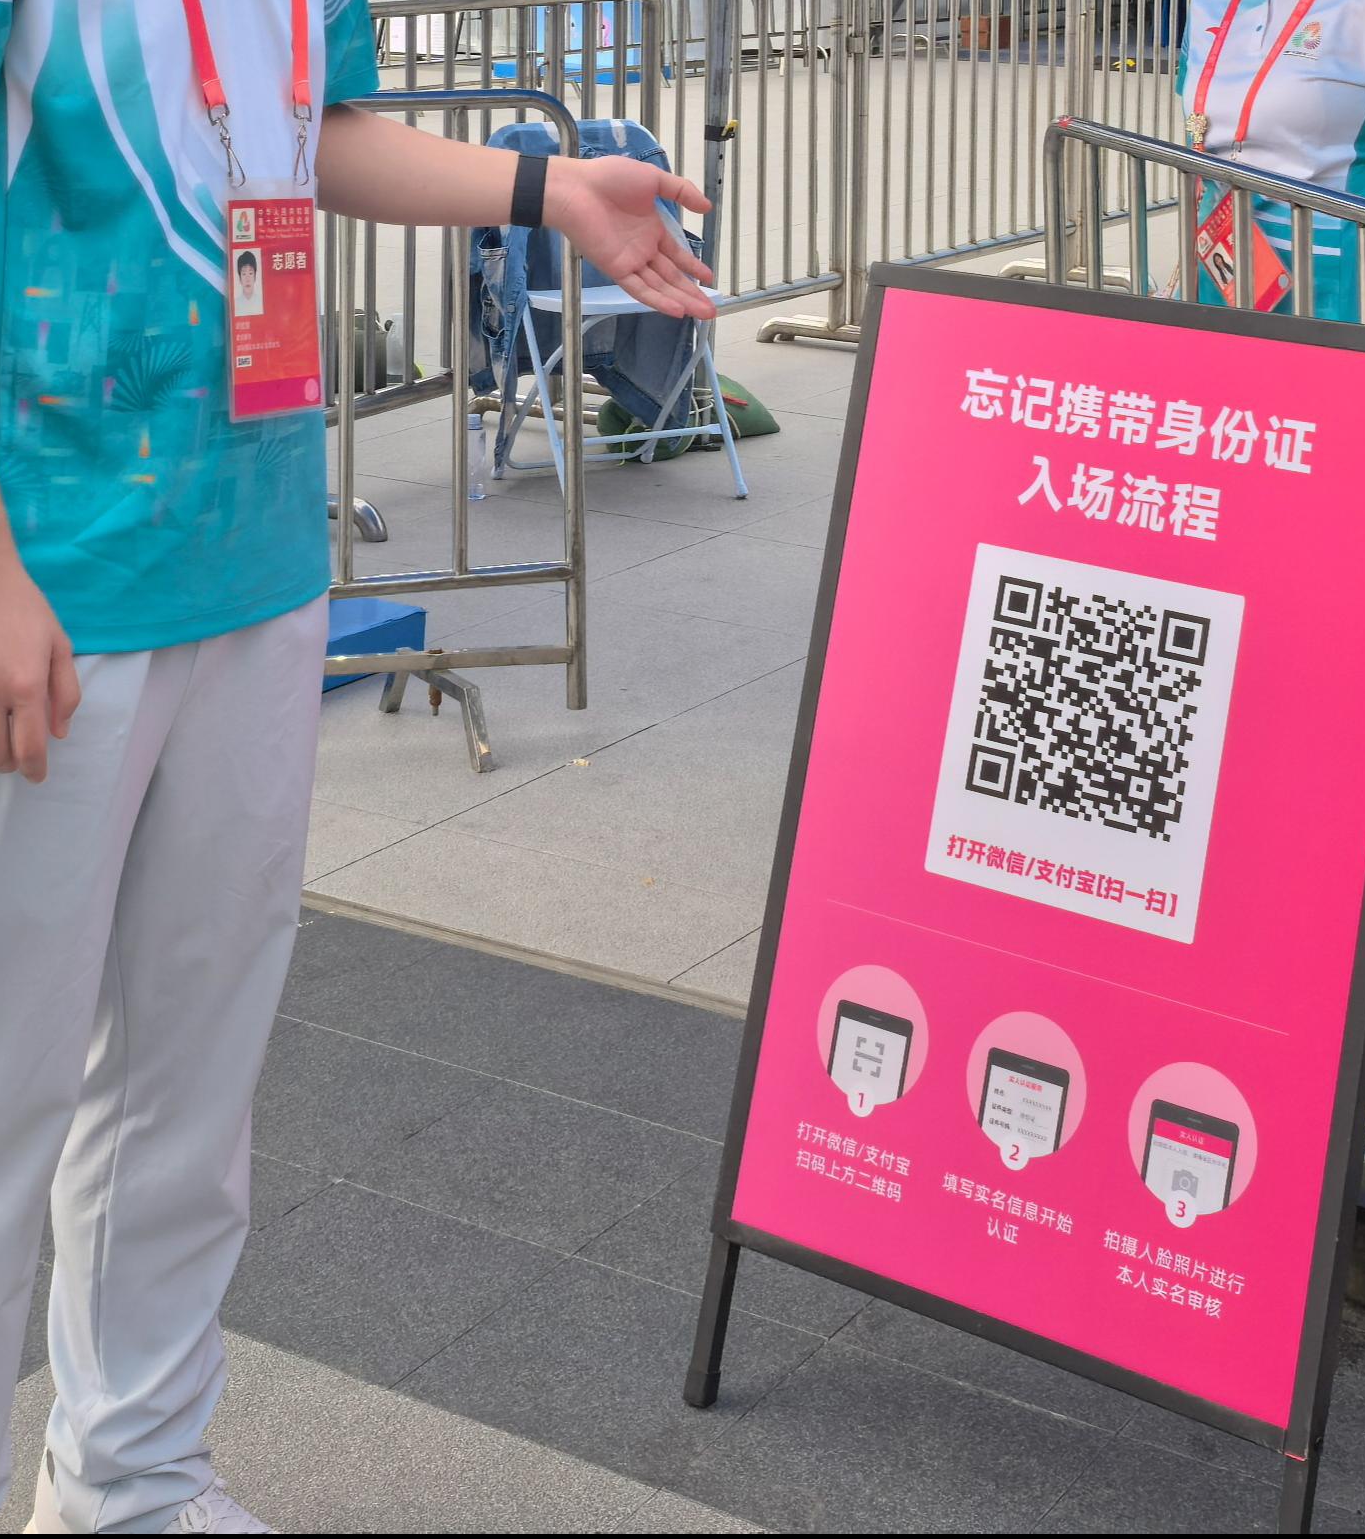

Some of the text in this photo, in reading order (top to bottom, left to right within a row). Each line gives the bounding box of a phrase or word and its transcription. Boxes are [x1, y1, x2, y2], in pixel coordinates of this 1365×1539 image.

[272, 251, 307, 270] 志愿者
[960, 367, 1317, 474] 忘记携带身份证
[1017, 455, 1221, 541] 入场流程
[857, 1092, 865, 1108] 1
[796, 1121, 911, 1176] 打开微信/支付宝
[1008, 1144, 1020, 1161] 2
[796, 1149, 902, 1202] 扫码上方二维码
[942, 1171, 1074, 1235] 填写实名信息开始
[1175, 1200, 1186, 1218] 3
[985, 1216, 1019, 1245] 认证
[1103, 1229, 1246, 1296] 拍摄人脸照片进行
[1115, 1265, 1224, 1319] 本人实名审核
